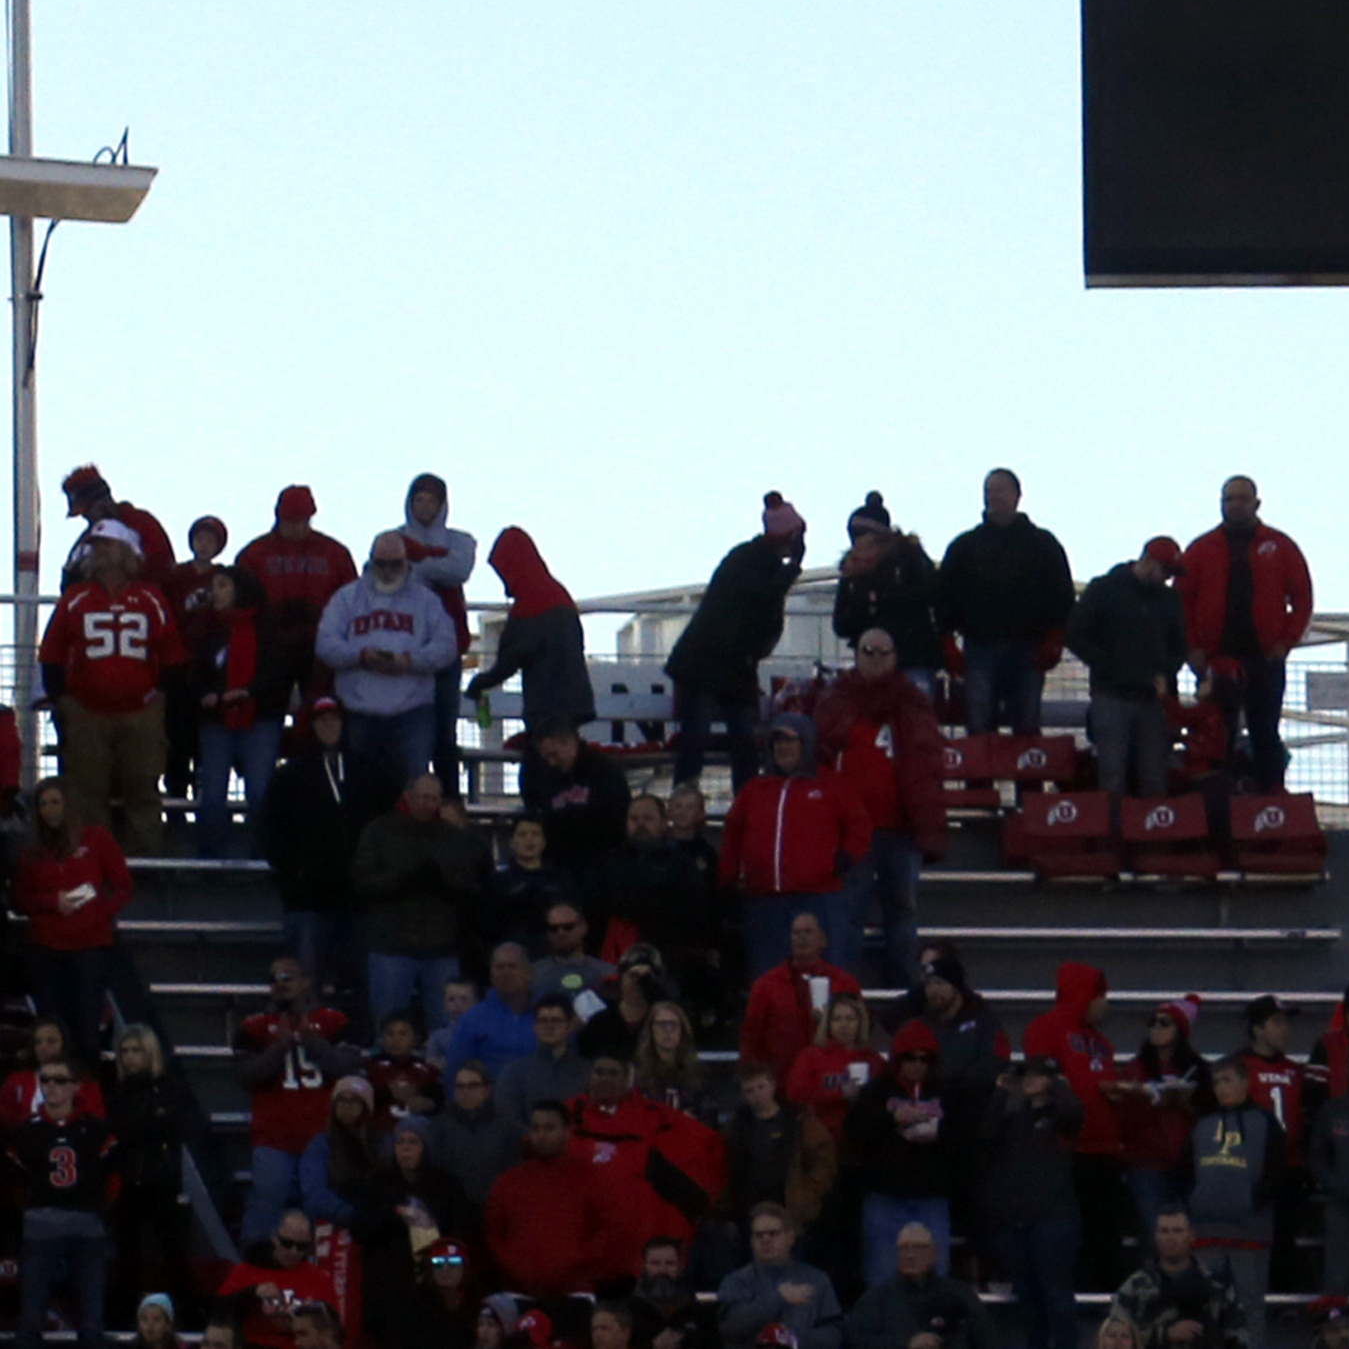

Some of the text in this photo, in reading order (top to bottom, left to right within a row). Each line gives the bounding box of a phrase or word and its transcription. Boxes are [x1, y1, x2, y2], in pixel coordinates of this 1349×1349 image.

[82, 611, 149, 661] 52
[282, 1046, 324, 1091] 15
[49, 1146, 78, 1190] 3
